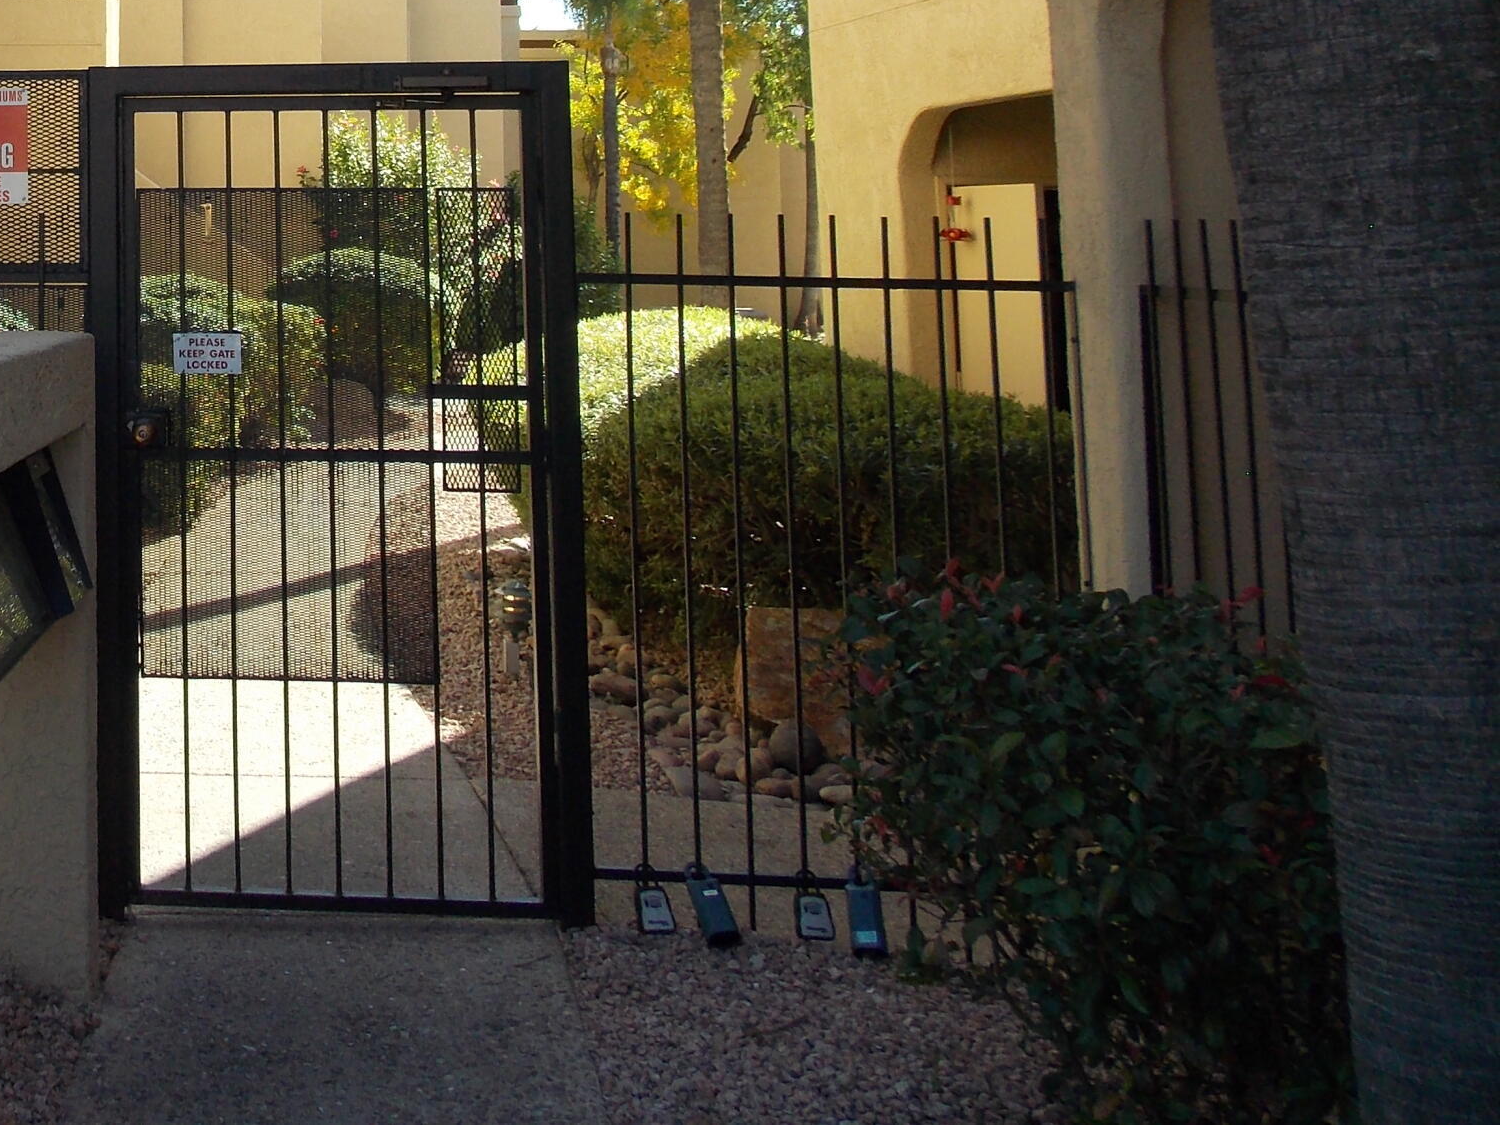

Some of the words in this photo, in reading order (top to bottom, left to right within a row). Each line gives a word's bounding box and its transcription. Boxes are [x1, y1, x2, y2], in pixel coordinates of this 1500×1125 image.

[188, 338, 226, 347] PLEASE
[178, 349, 205, 358] KEEP
[209, 349, 236, 359] GATE
[186, 360, 228, 370] LOCKED
